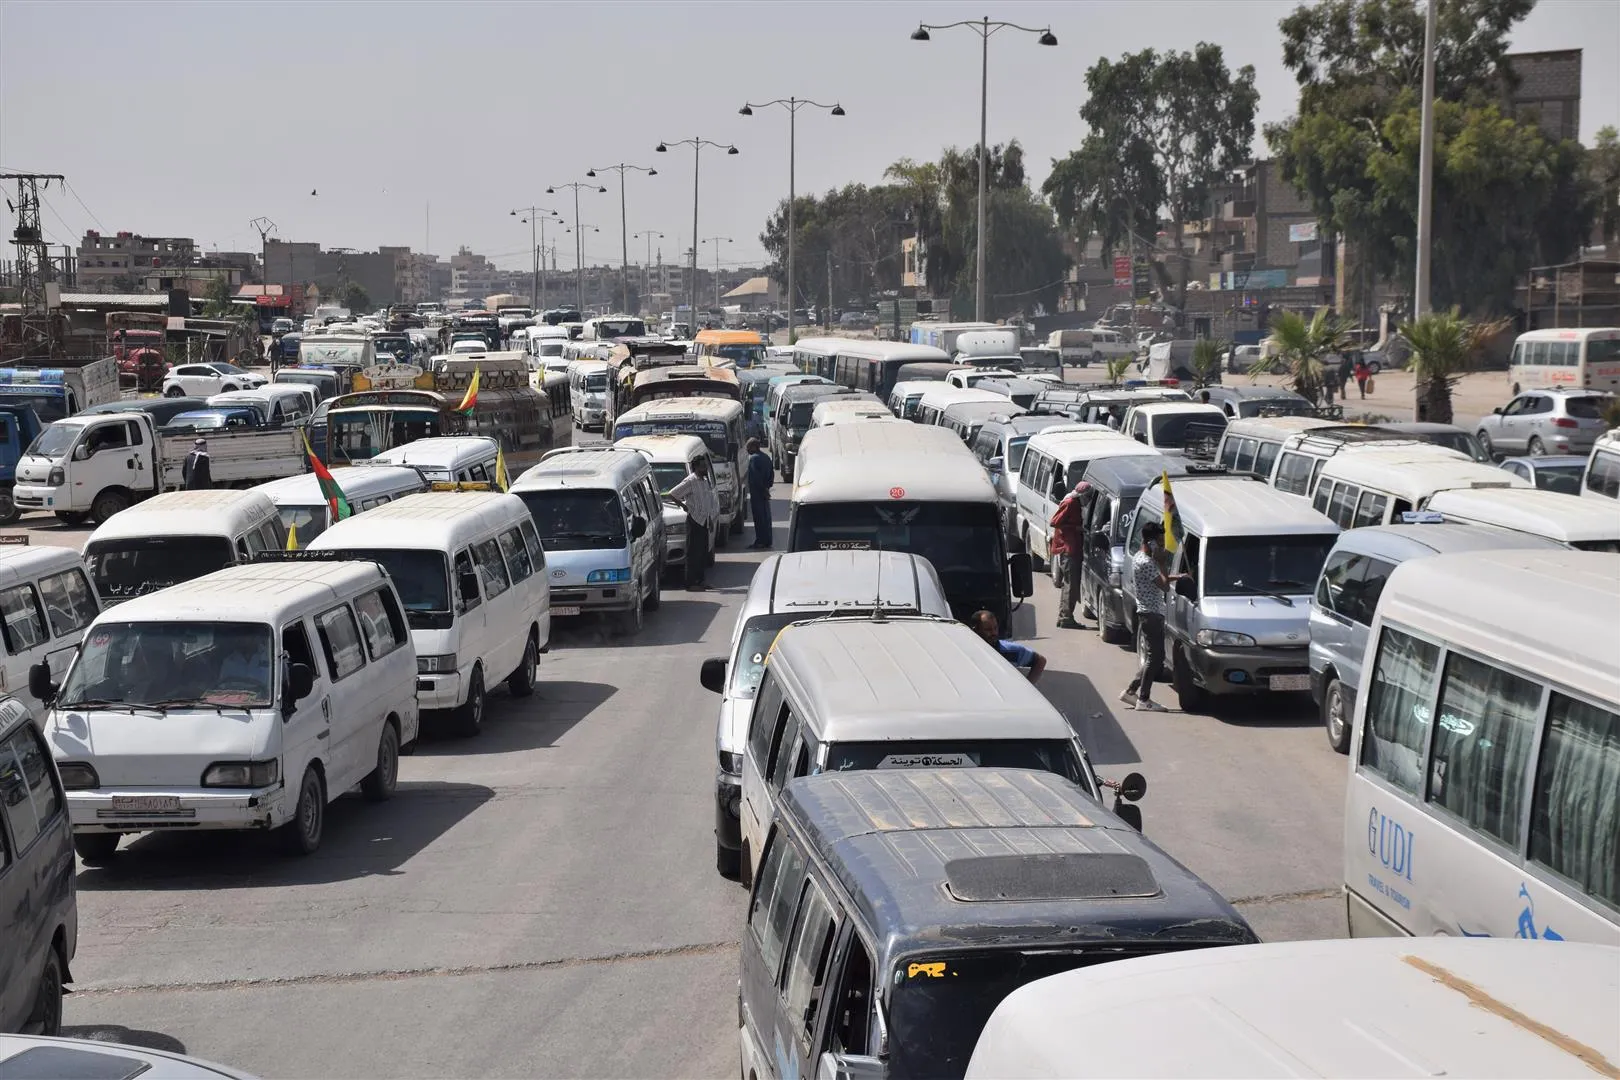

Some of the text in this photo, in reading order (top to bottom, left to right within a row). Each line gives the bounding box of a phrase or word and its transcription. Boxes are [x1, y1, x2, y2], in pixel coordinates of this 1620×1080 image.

[891, 488, 904, 498] 20
[932, 757, 963, 766] الحسكة
[1368, 807, 1414, 881] GUDI
